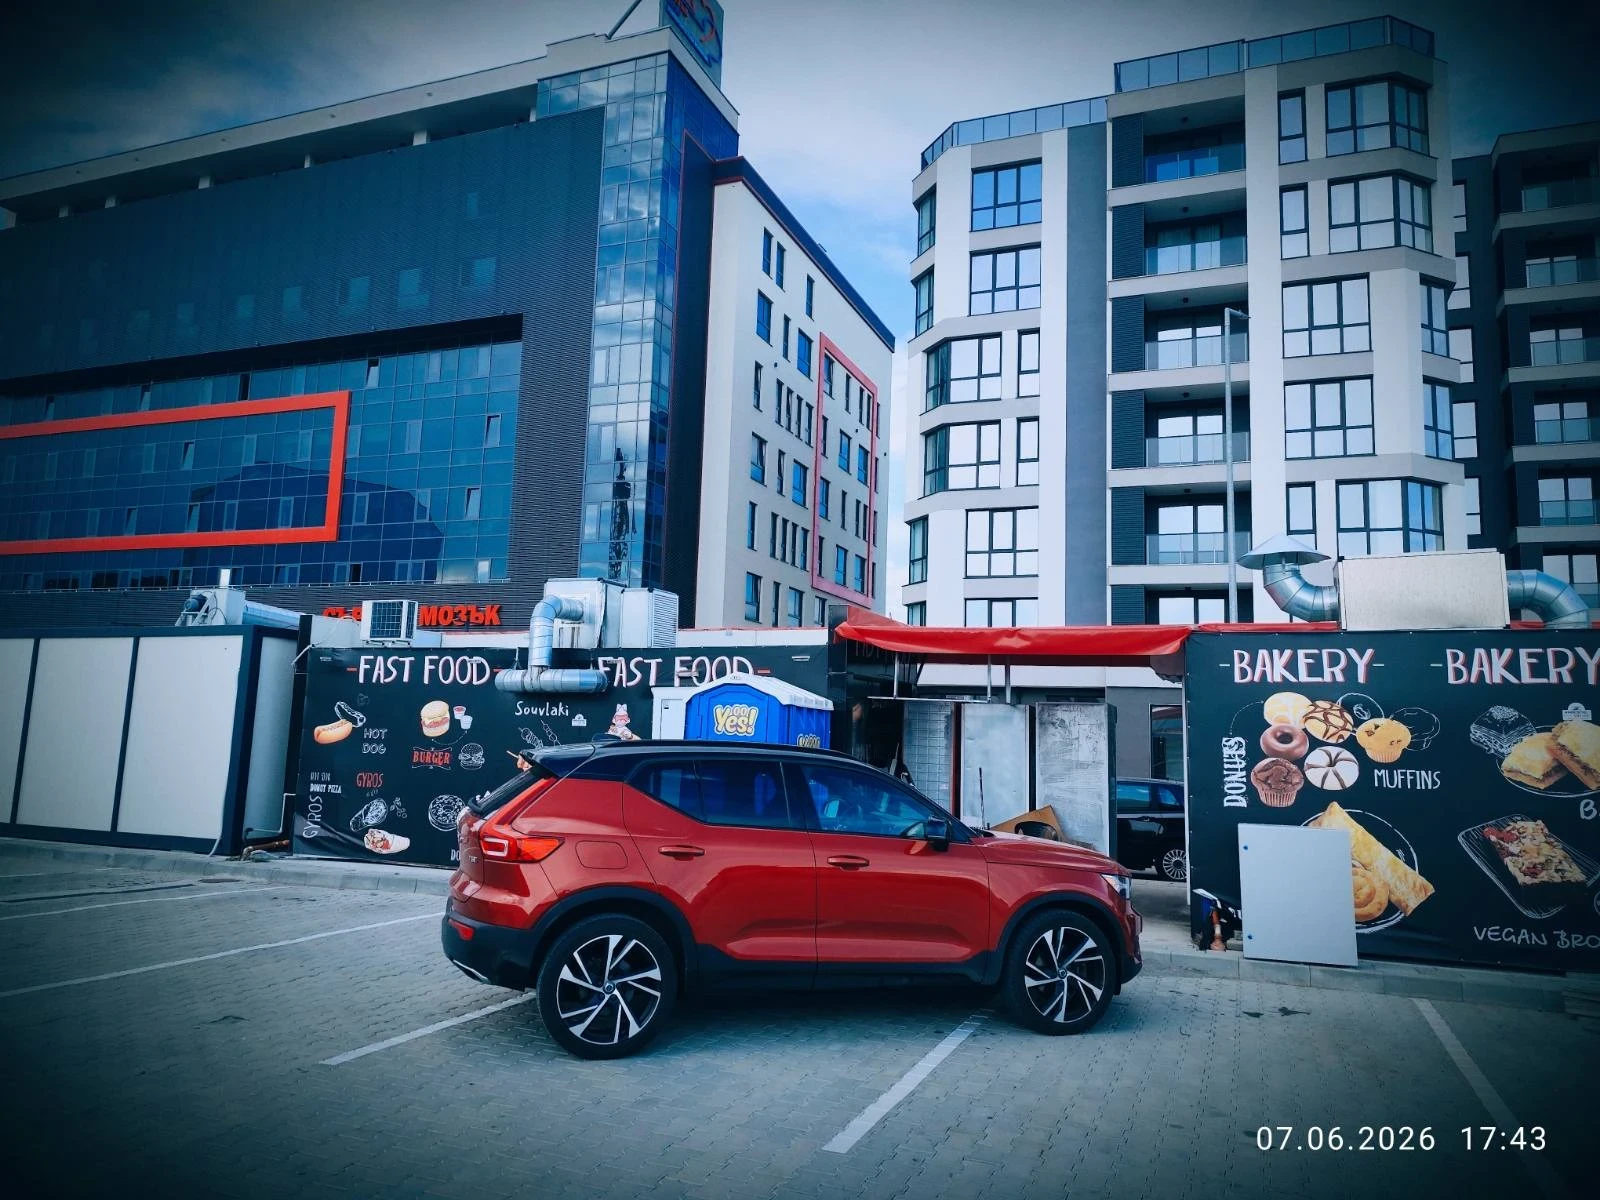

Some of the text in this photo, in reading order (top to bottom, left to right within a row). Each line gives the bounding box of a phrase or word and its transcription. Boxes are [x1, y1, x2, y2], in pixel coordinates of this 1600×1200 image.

[419, 605, 501, 626] МОЗЪК
[359, 656, 490, 685] FAST FOOD
[598, 656, 754, 687] FAST FOOD
[1233, 648, 1375, 683] BAKERY
[1446, 647, 1600, 685] BAKERY
[515, 701, 569, 716] Souvlaki
[714, 706, 758, 735] Yes!
[364, 728, 388, 739] HOT
[362, 743, 386, 754] DOG
[413, 751, 450, 765] BURGER
[356, 772, 383, 788] GYROS
[1374, 769, 1440, 790] MUFFINS
[302, 795, 322, 838] GYROS
[1473, 926, 1548, 945] VEGAN
